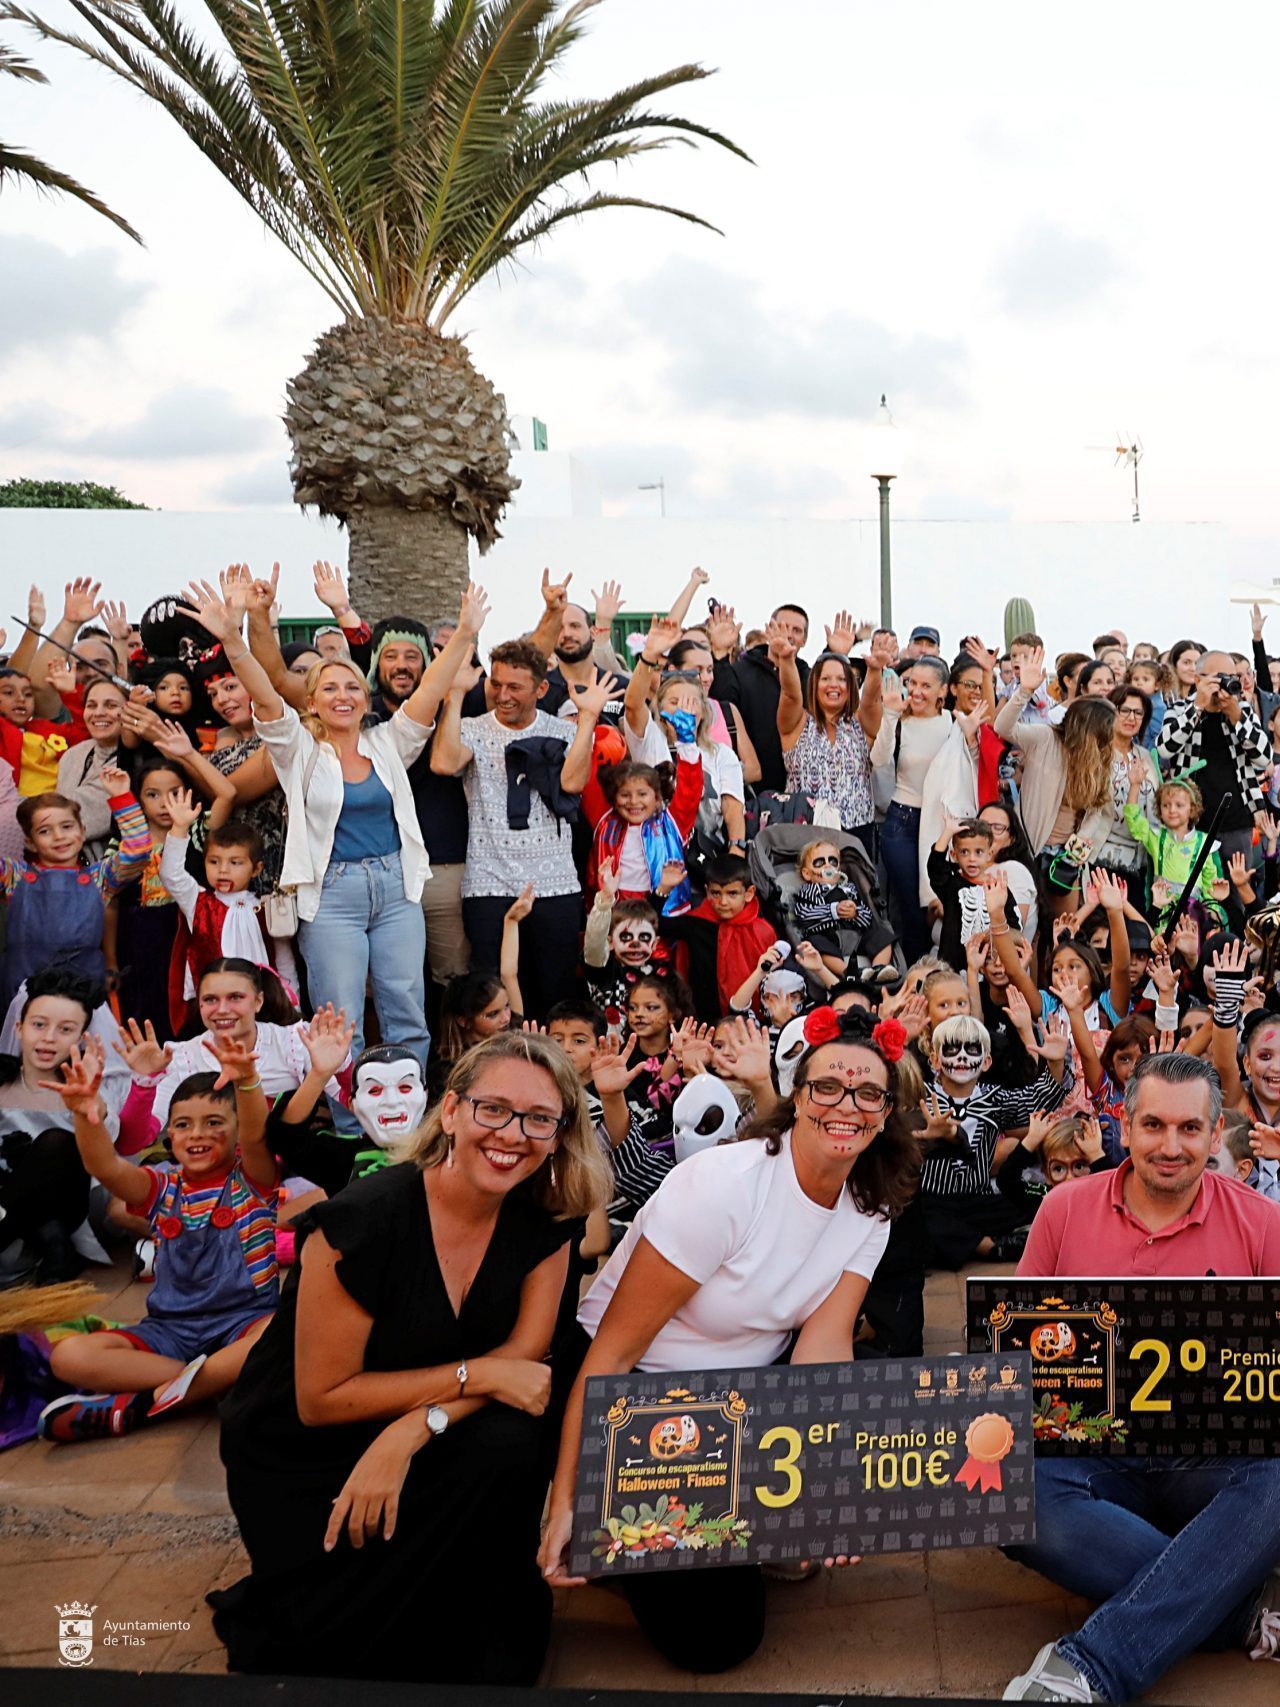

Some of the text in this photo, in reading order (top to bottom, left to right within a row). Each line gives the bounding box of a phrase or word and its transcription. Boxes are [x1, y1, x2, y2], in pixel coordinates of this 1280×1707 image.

[1049, 1365, 1103, 1375] escaparatismo
[1067, 1375, 1103, 1388] Finaos
[855, 1427, 957, 1451] Premio de
[618, 1461, 728, 1477] Concurso de escaparatismo
[861, 1449, 951, 1490] 100€
[617, 1473, 727, 1493] Halloween Finaos
